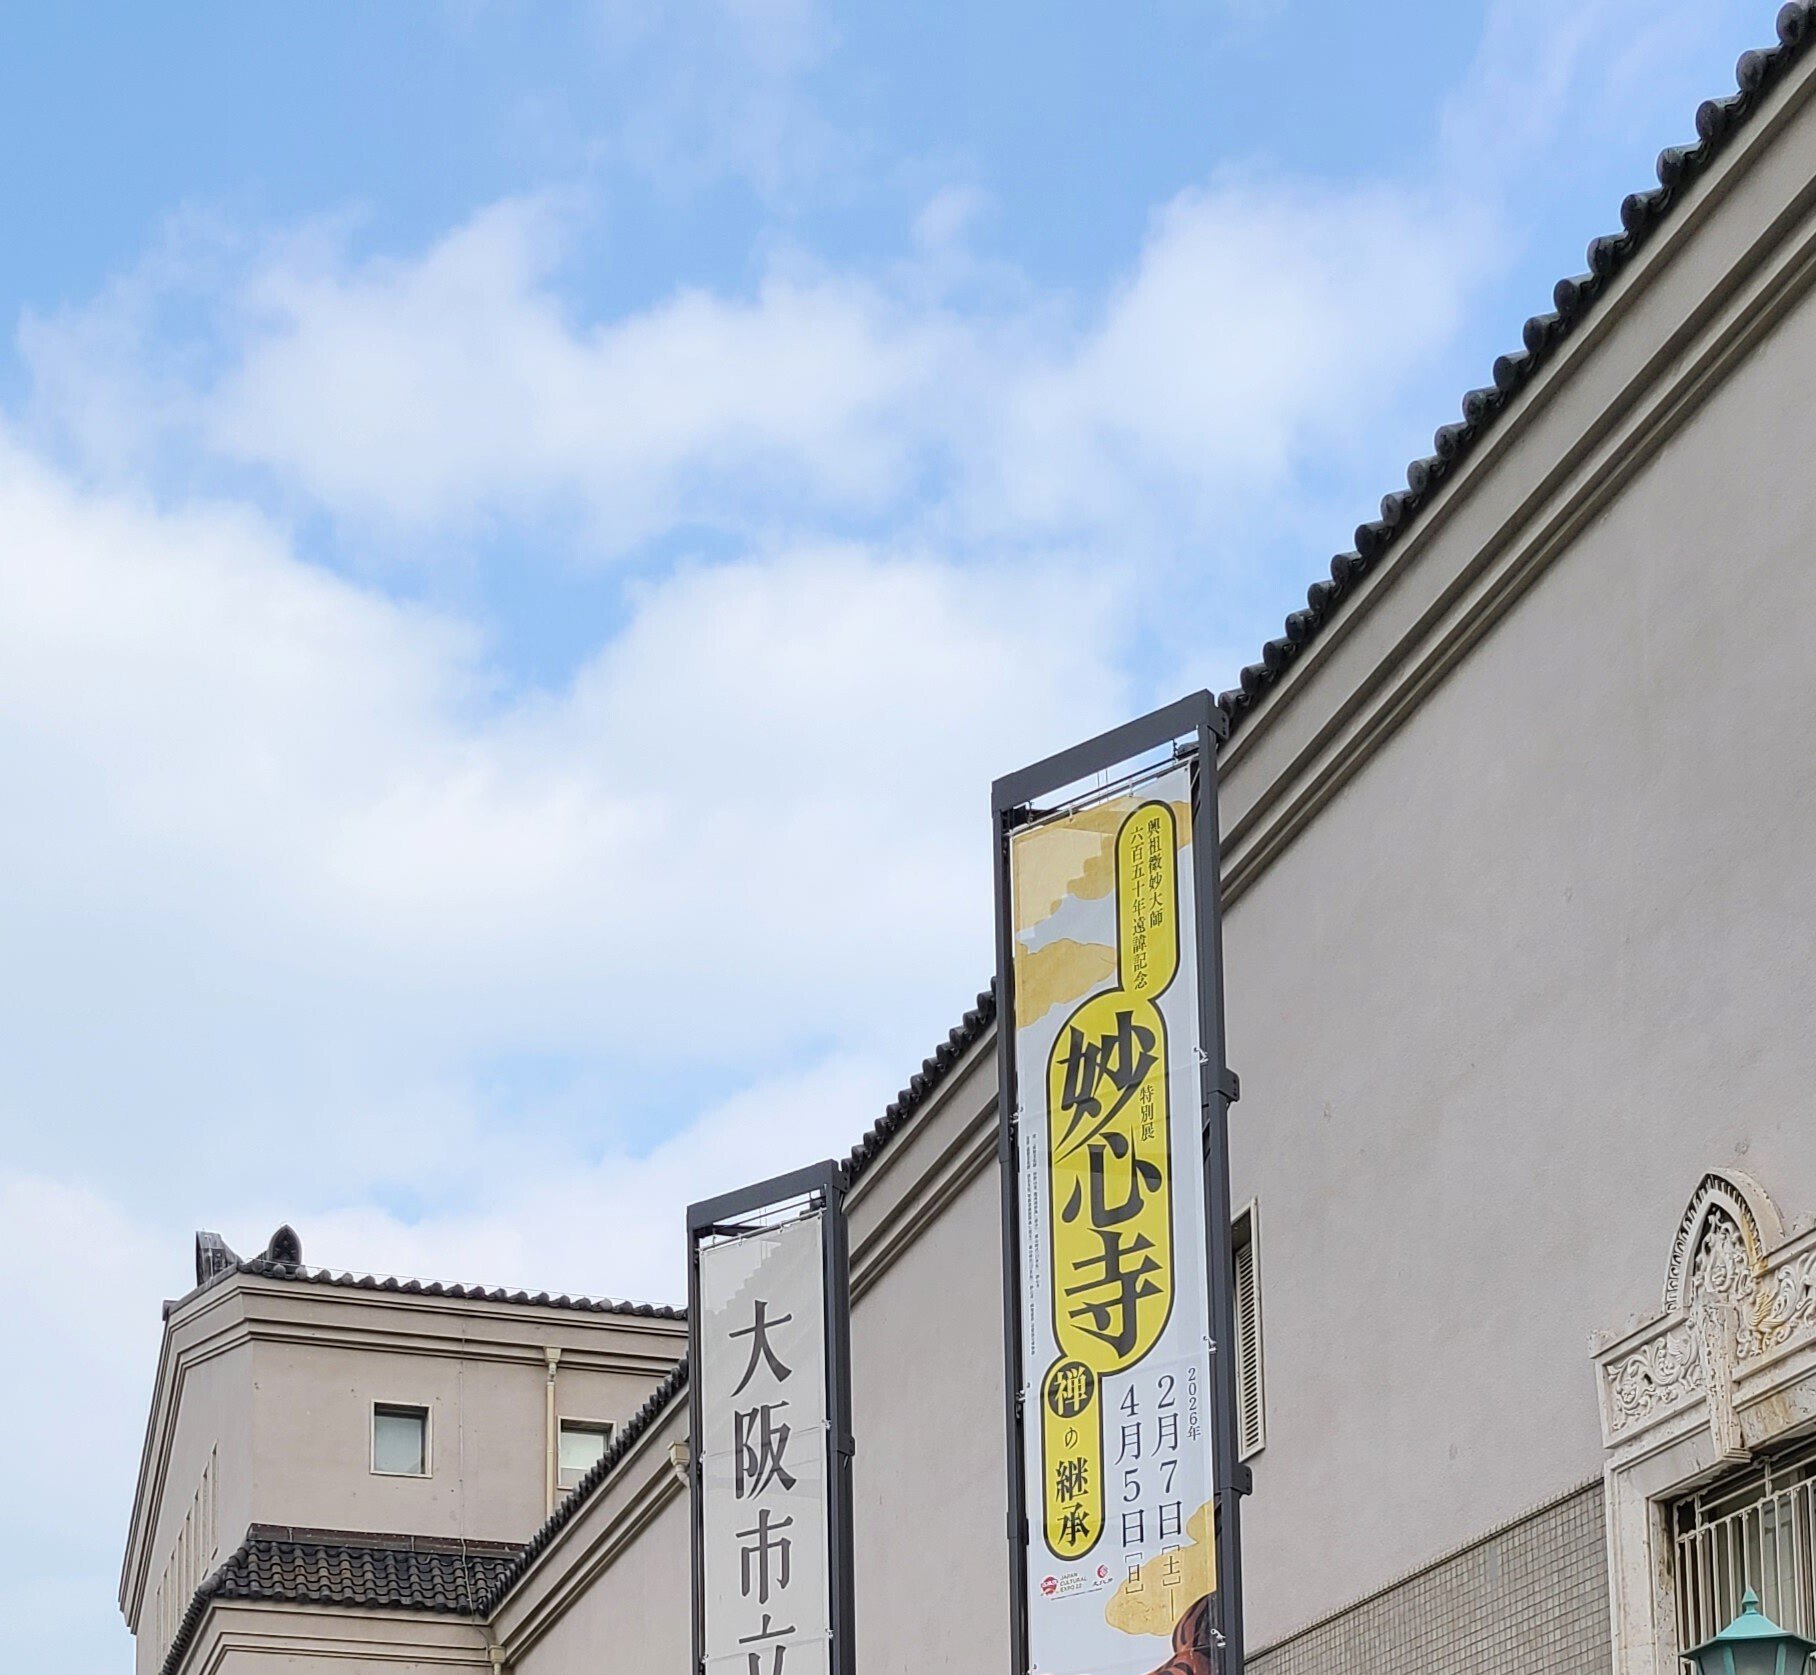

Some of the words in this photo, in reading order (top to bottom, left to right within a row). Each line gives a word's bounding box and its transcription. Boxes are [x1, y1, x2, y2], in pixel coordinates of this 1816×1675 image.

[1139, 1085, 1154, 1142] 特別展
[1054, 1010, 1163, 1358] 妙心寺
[1054, 1366, 1090, 1547] 禅の継承
[1187, 1367, 1201, 1441] 2026年
